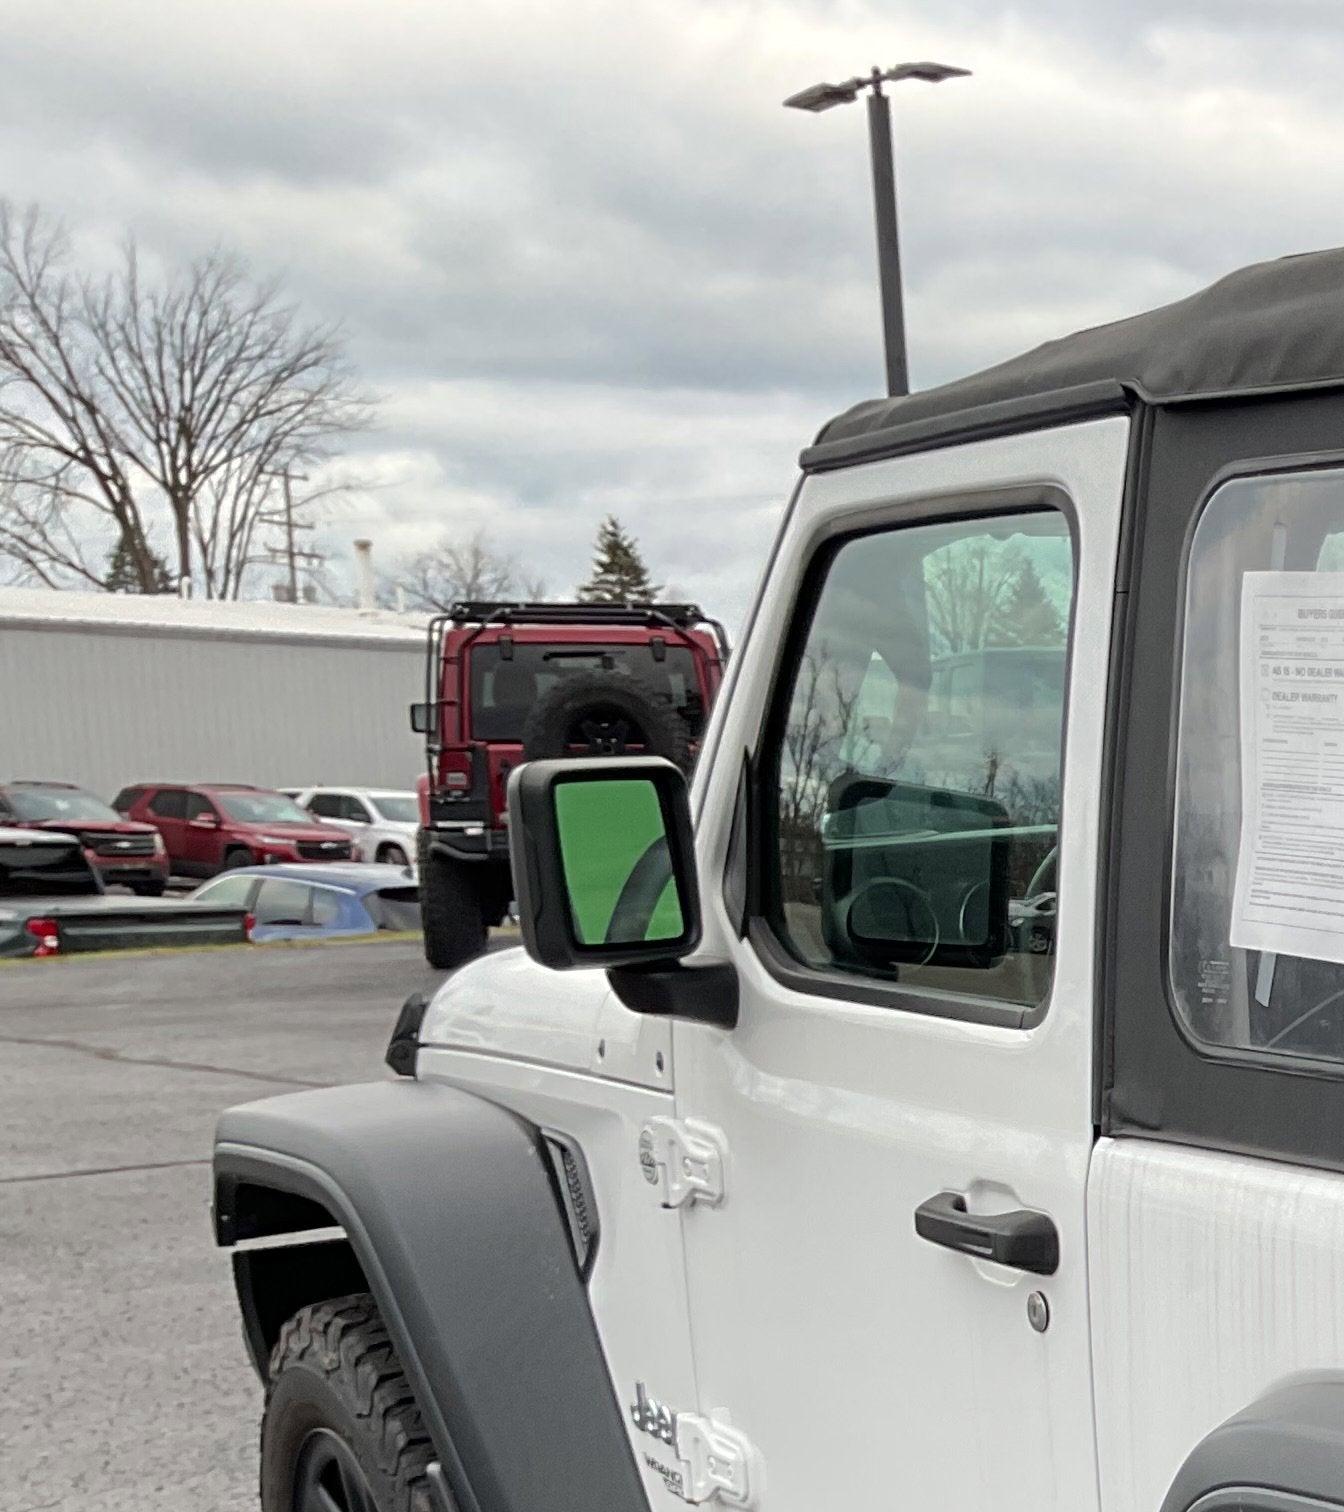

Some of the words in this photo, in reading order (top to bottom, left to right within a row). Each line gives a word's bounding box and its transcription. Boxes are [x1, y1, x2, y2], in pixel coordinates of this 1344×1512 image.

[1296, 667, 1305, 676] NO
[1307, 667, 1333, 677] DEALER
[1272, 691, 1300, 702] DEALER
[1301, 693, 1338, 703] WARRANTY
[631, 1382, 677, 1446] Jeep
